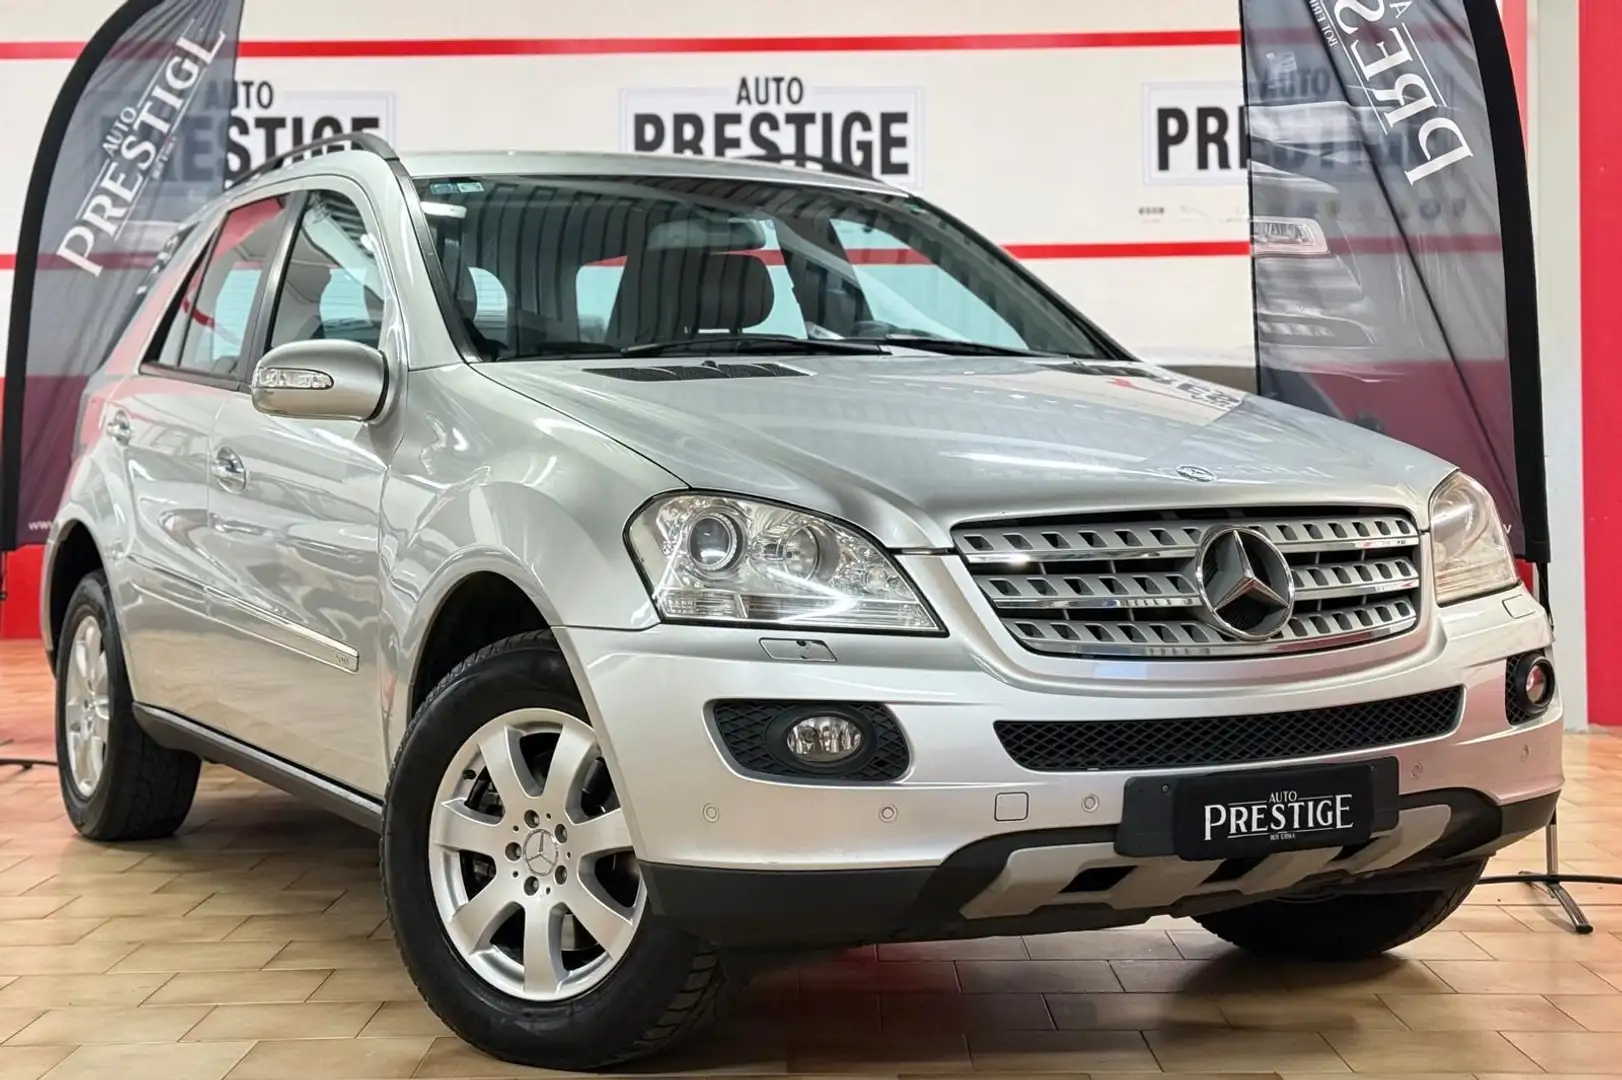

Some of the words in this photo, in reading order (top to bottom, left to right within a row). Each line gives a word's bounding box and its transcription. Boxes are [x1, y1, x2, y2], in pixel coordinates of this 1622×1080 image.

[736, 76, 804, 105] AUTO
[102, 106, 137, 156] AUTO
[1269, 791, 1297, 803] AUTO
[1204, 793, 1353, 841] PRESTIGE
